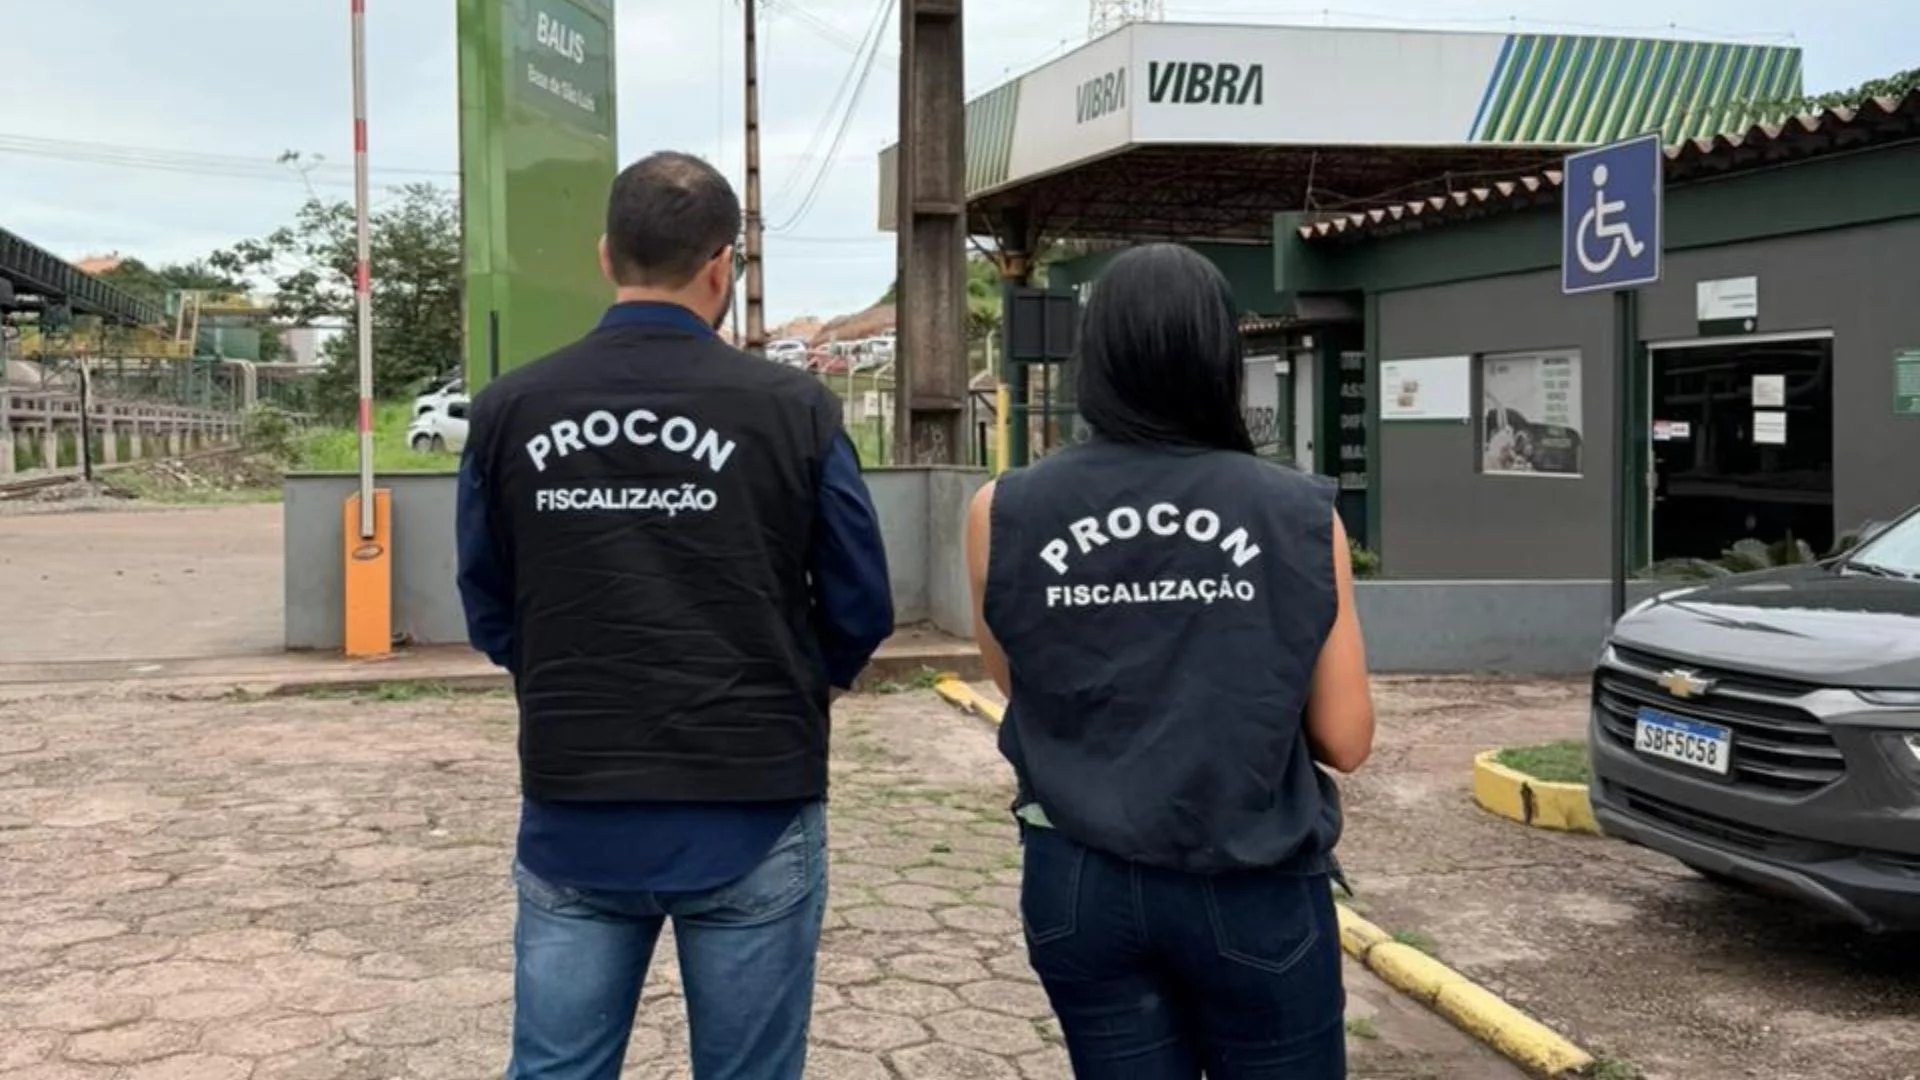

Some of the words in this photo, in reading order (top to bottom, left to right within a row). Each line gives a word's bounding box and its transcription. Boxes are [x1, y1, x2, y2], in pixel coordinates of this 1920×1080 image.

[537, 11, 584, 64] BALIS
[1075, 66, 1125, 124] VIBRA
[1148, 61, 1264, 105] VIBRA
[525, 409, 736, 473] PROCON
[536, 483, 718, 517] FISCALIZAÇÃO
[1039, 502, 1261, 575] PROCON
[1046, 573, 1255, 607] FISCALIZAÇÃO
[1644, 724, 1717, 765] SBF5C58
